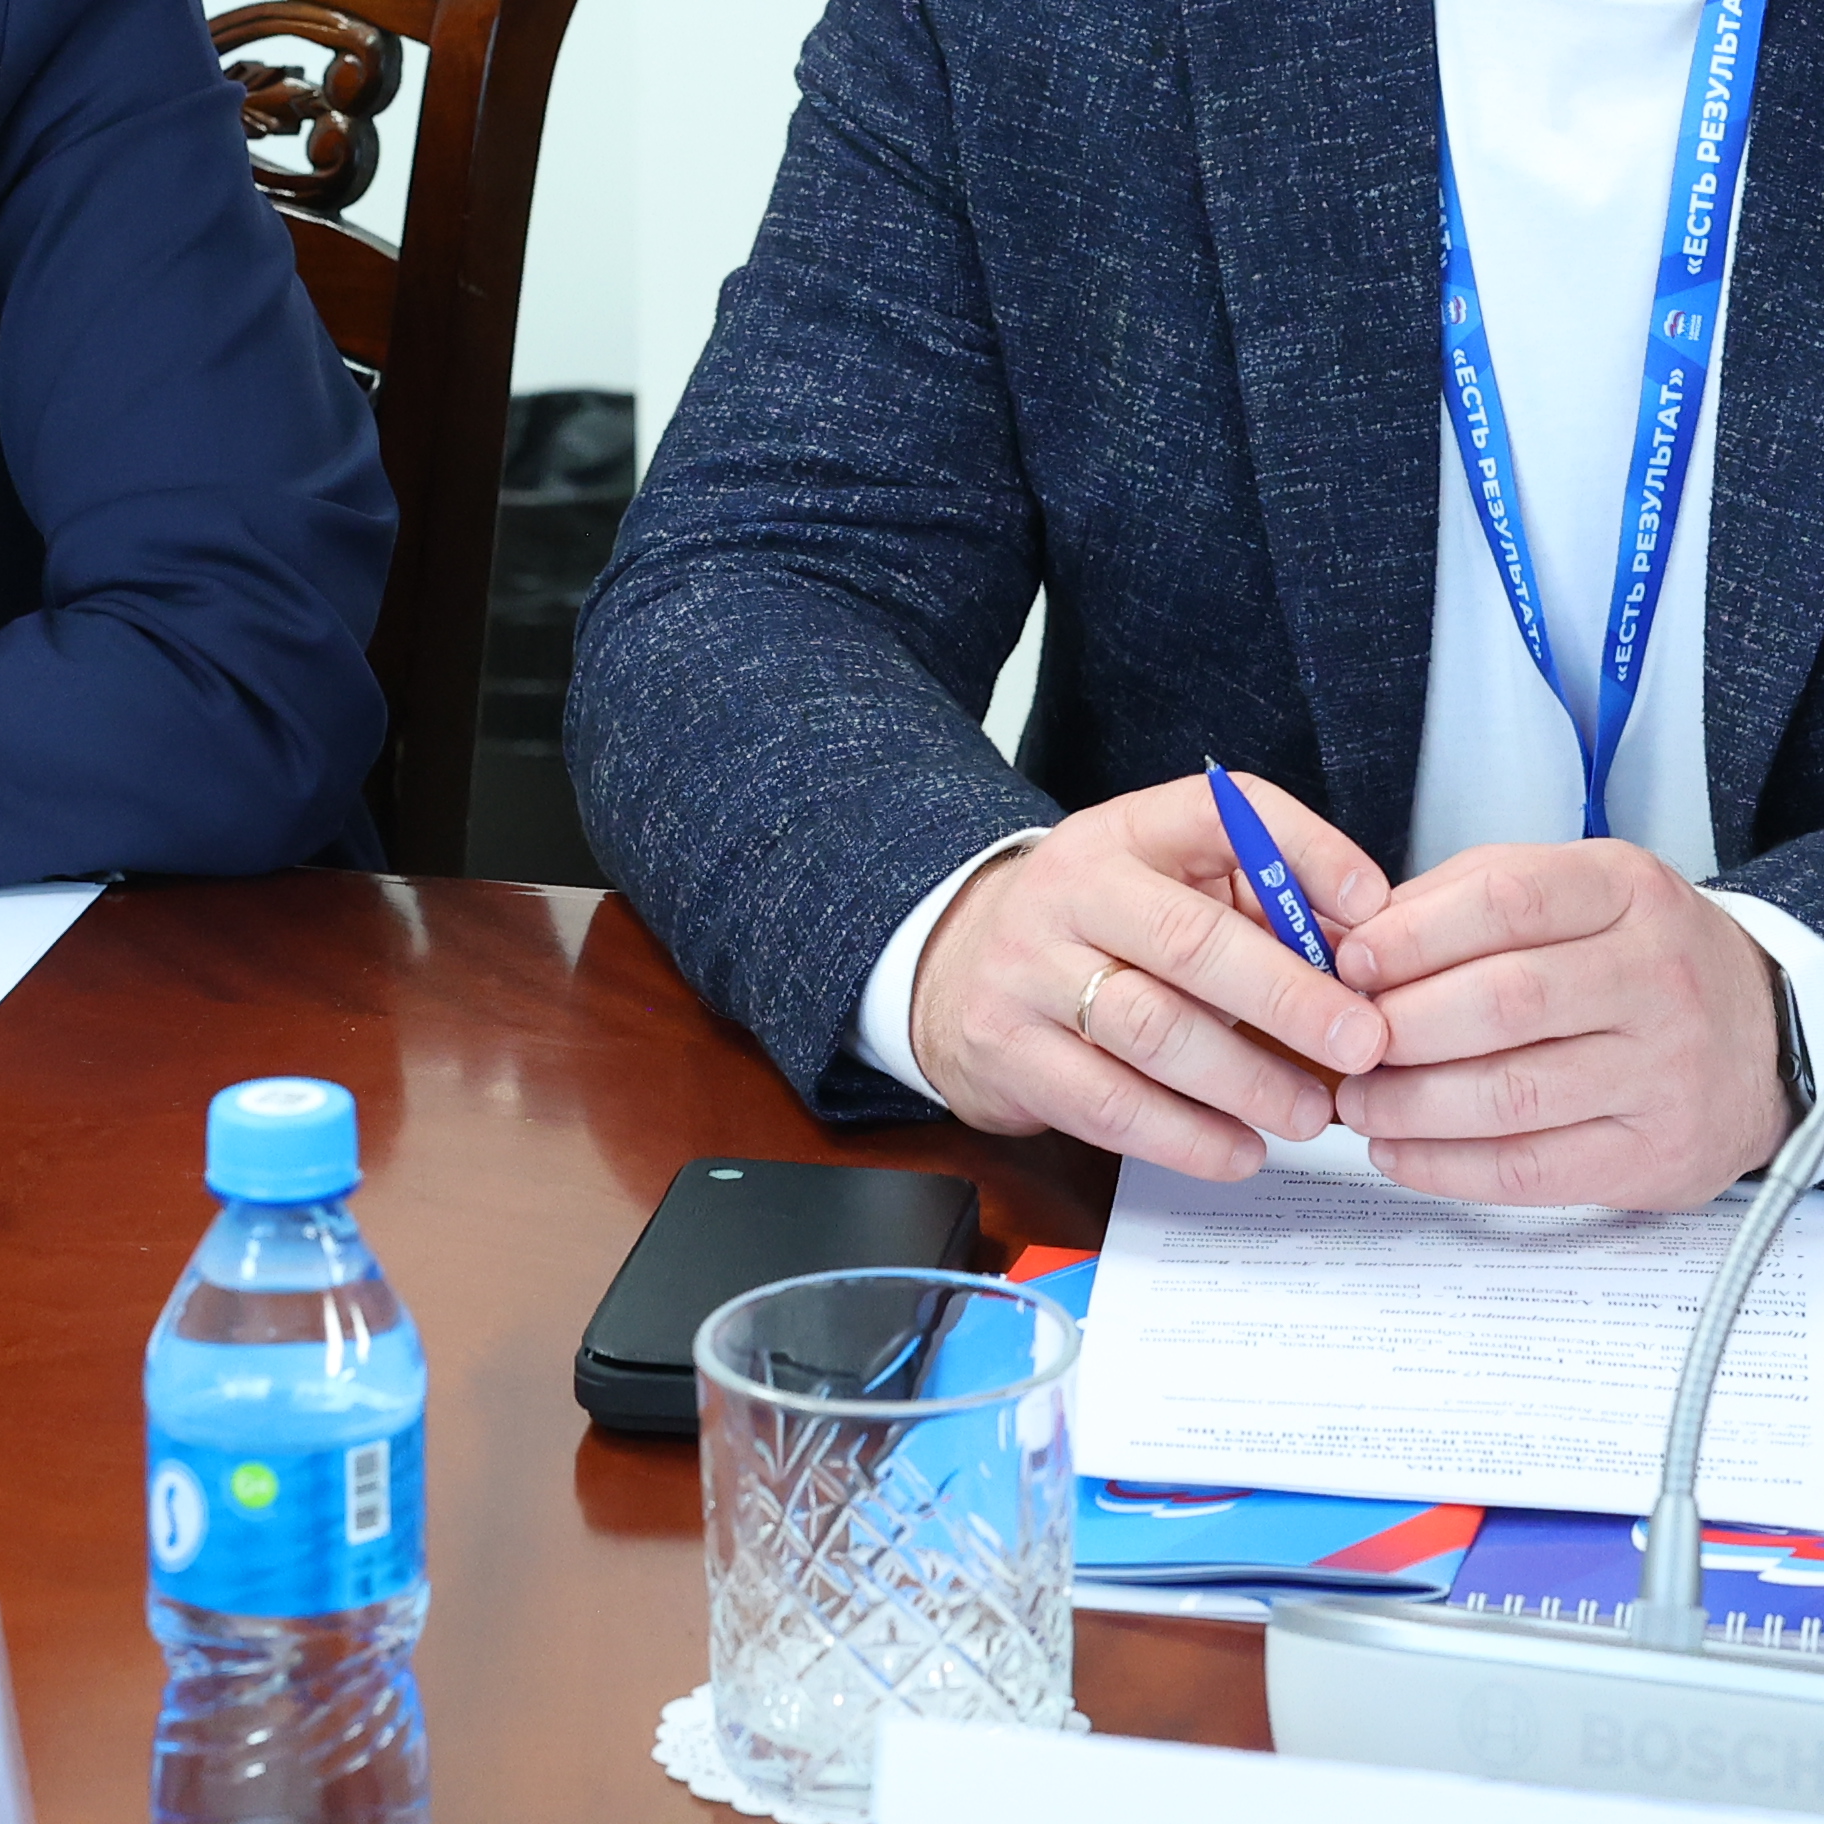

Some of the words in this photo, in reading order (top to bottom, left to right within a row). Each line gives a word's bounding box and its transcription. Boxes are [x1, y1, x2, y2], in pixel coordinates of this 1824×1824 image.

[1681, 172, 1719, 276] «ЕСТЬ
[1452, 348, 1490, 450] «ЕСТЬ
[1478, 456, 1544, 660] РЕЗУЛЬТАТ»
[1615, 582, 1646, 683] «ЕСТЬ
[1632, 367, 1685, 574] РЕЗУЛЬТАТ»
[1277, 888, 1308, 934] ЕСТЬ
